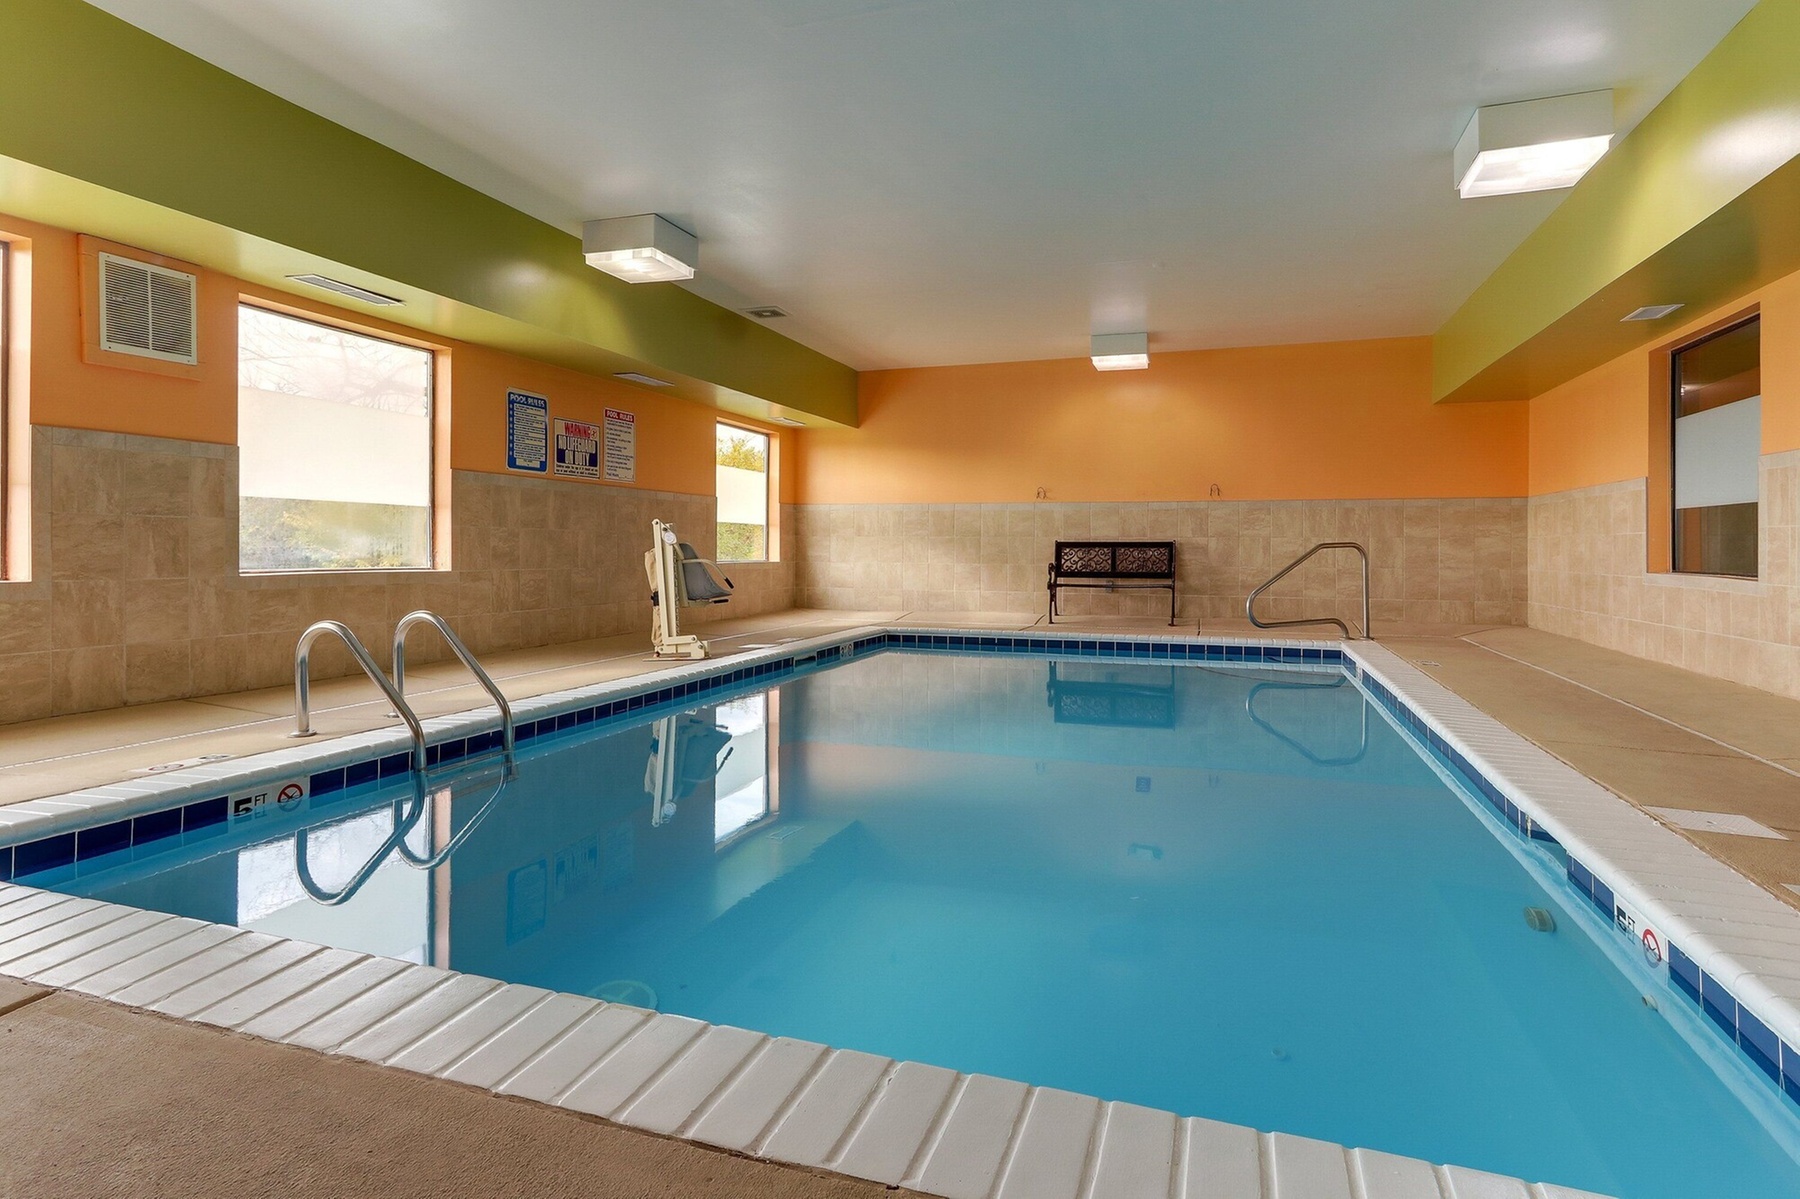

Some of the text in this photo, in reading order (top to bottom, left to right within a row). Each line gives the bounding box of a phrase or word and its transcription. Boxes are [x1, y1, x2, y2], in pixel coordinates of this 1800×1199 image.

[510, 394, 545, 407] POOL RULES
[606, 410, 633, 421] POOL RULES
[564, 422, 591, 439] WARNING
[558, 435, 596, 454] NO LIFEGUARD
[565, 450, 590, 467] ON DUTY
[234, 793, 268, 816] 5 FT
